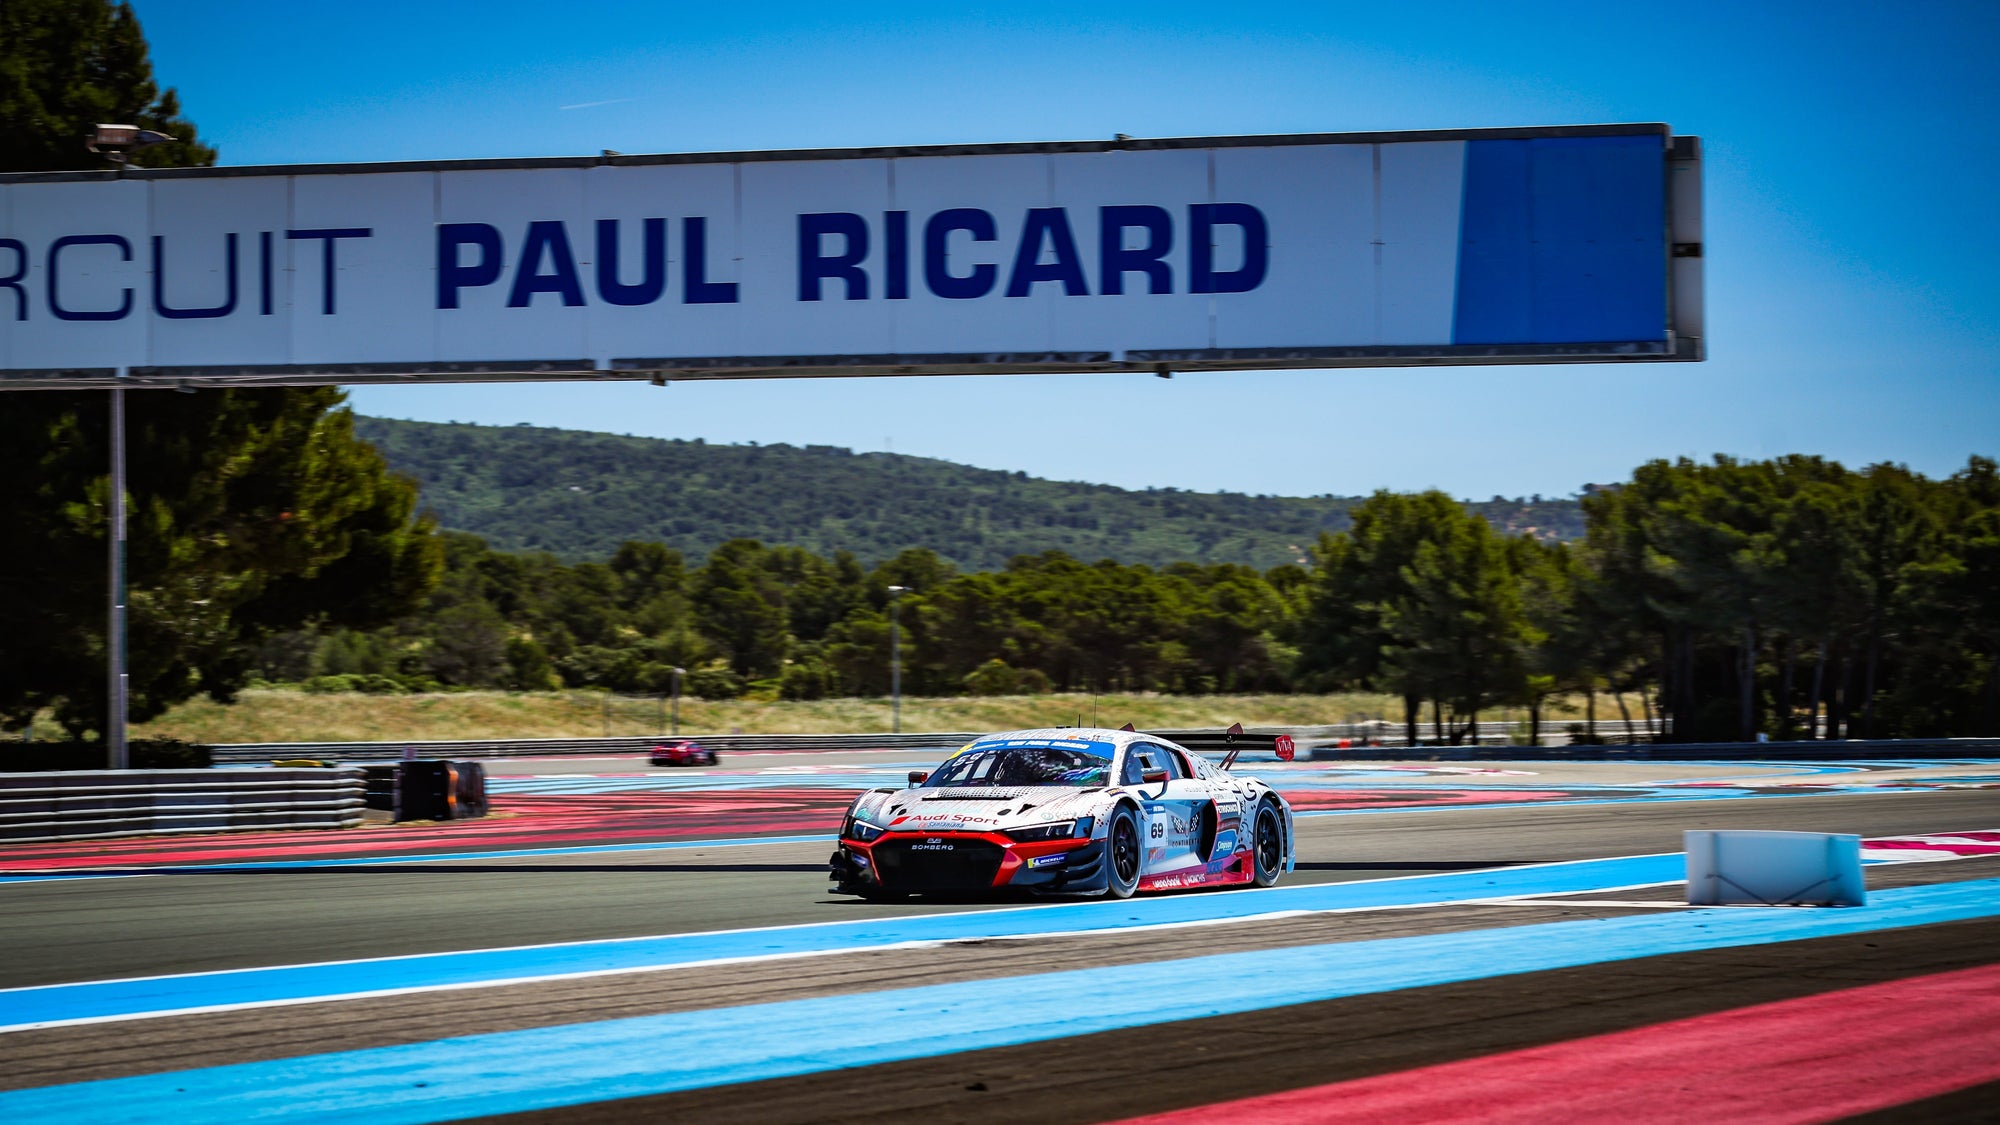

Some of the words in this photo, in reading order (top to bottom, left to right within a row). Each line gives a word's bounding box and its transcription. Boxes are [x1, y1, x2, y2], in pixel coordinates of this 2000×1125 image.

[435, 216, 740, 310] PAUL
[796, 202, 1272, 302] RICARD
[951, 815, 1000, 825] Sport
[1151, 822, 1164, 839] 69
